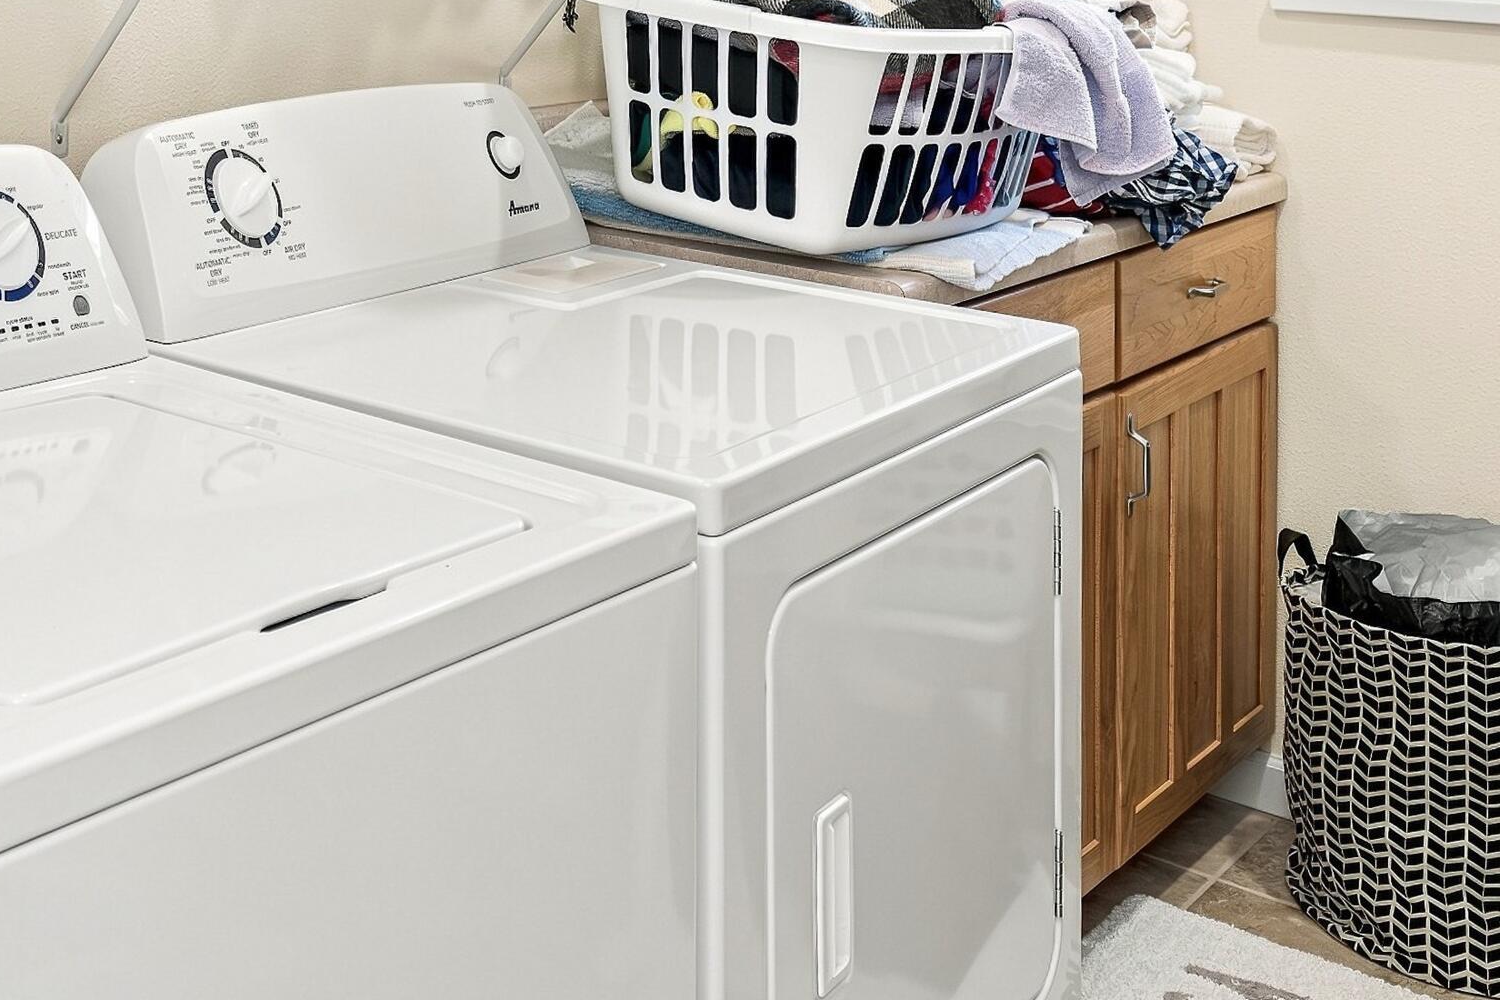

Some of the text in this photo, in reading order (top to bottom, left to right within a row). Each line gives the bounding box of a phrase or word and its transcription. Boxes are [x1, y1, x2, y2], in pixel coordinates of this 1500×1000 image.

[159, 131, 196, 144] AUTOMATIC
[508, 200, 541, 217] Amana
[44, 227, 78, 241] DELICATE
[262, 249, 272, 257] OFF
[196, 257, 232, 271] AUTOMATIC
[62, 268, 87, 281] START
[209, 267, 223, 278] DRY
[70, 321, 92, 332] CANCEL
